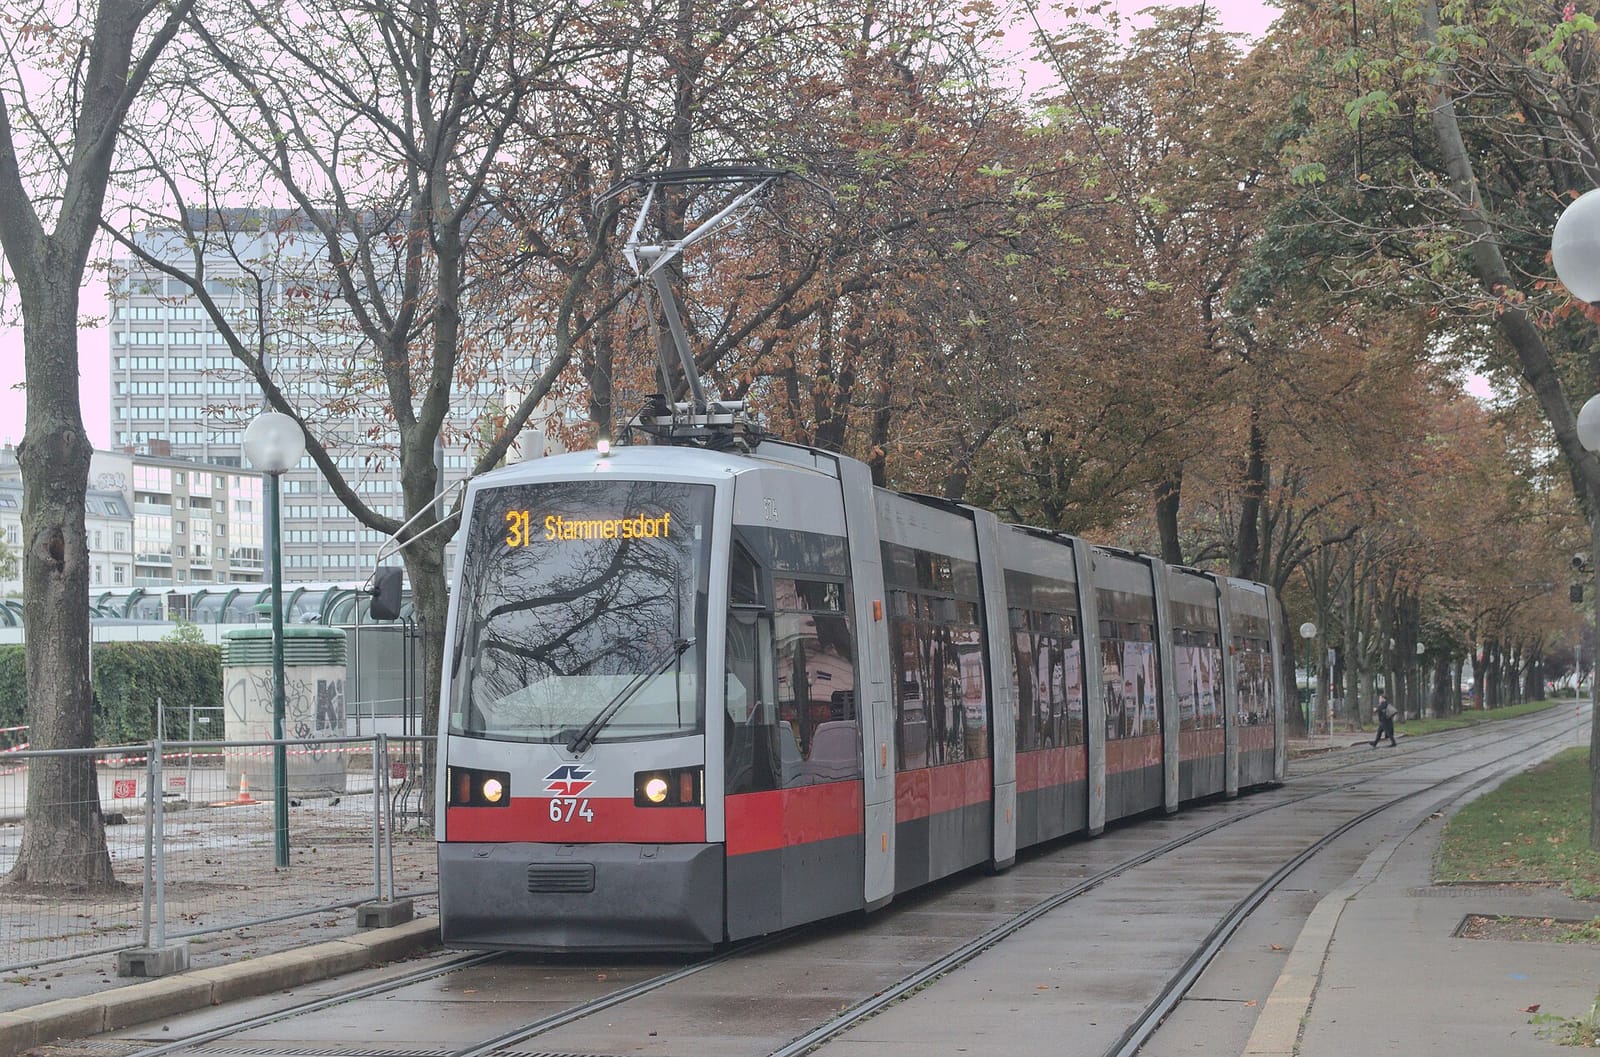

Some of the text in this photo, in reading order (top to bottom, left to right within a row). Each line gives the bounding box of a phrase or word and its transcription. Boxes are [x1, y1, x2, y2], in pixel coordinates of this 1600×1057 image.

[505, 510, 671, 547] 31 Stammersdorf
[549, 798, 594, 823] 674
